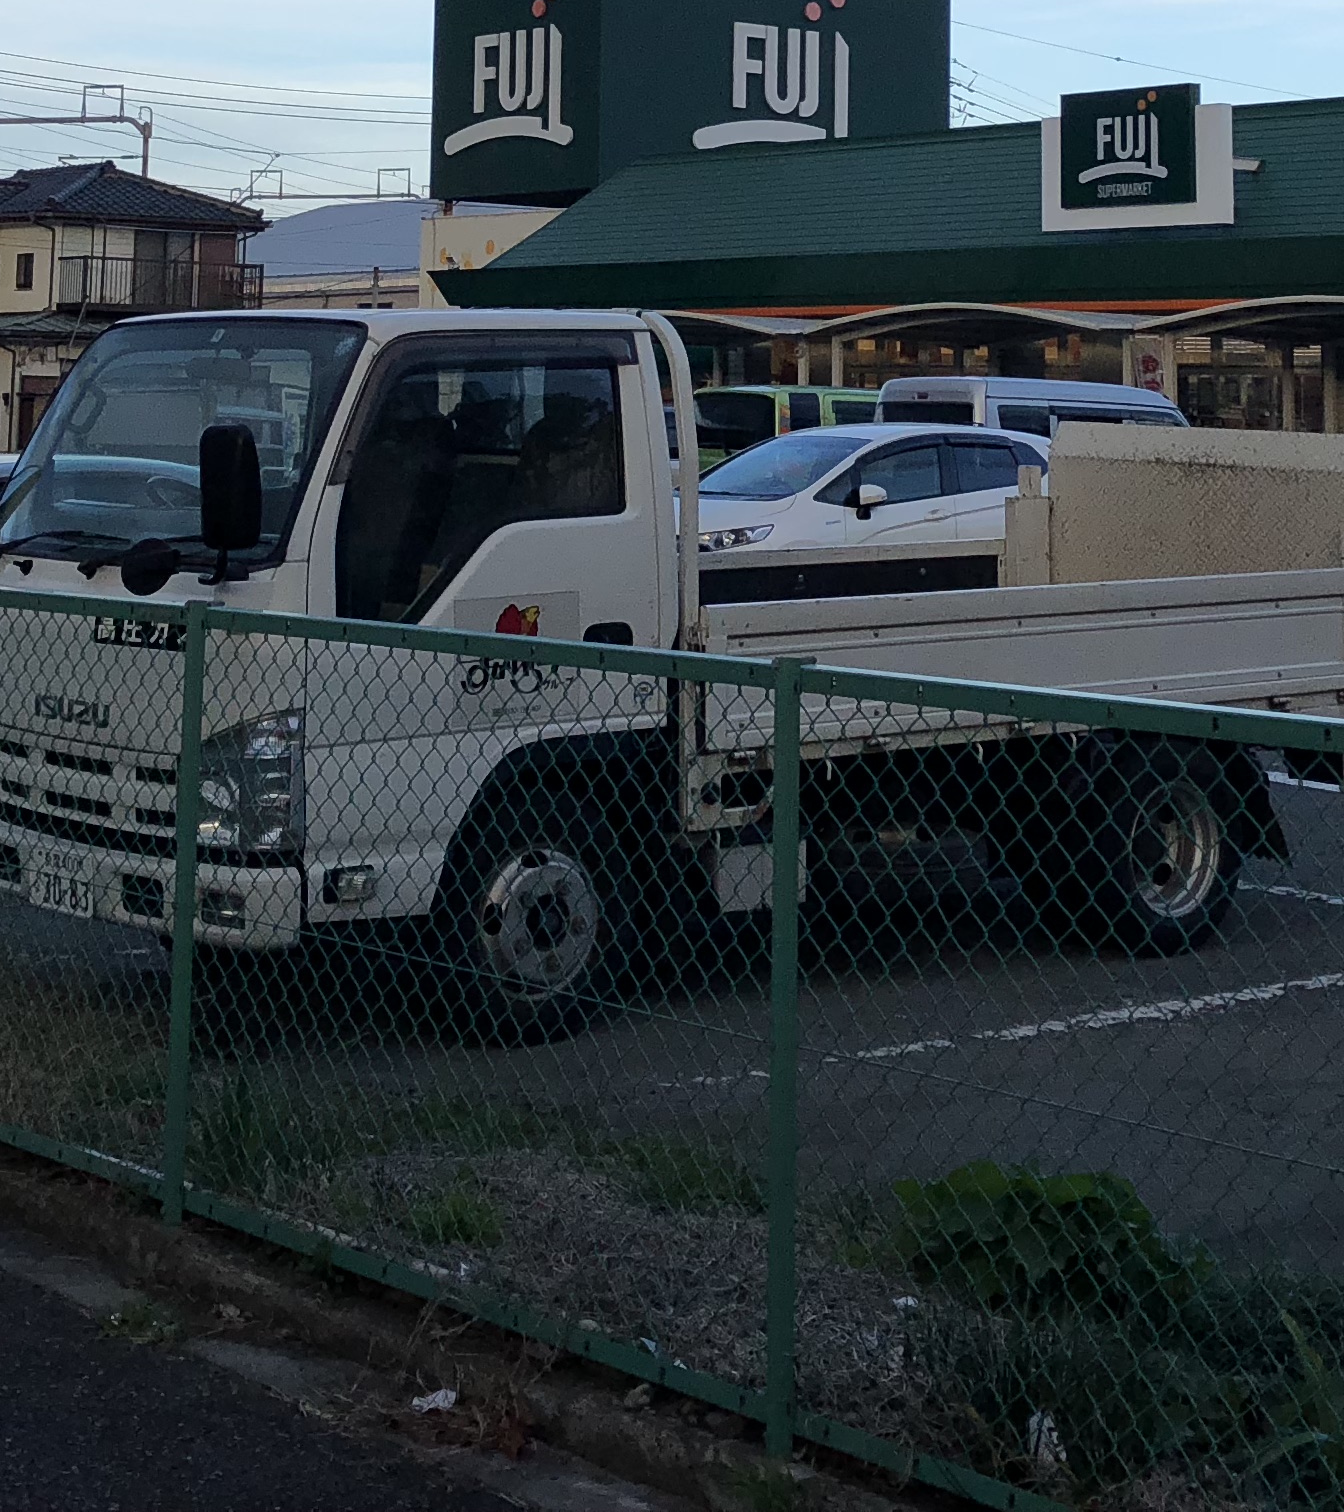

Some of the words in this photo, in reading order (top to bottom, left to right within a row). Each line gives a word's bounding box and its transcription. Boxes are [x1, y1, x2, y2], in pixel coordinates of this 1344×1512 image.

[1096, 90, 1159, 170] FUJI
[1096, 181, 1153, 199] SUPERMARKET
[35, 695, 109, 728] ISUZU
